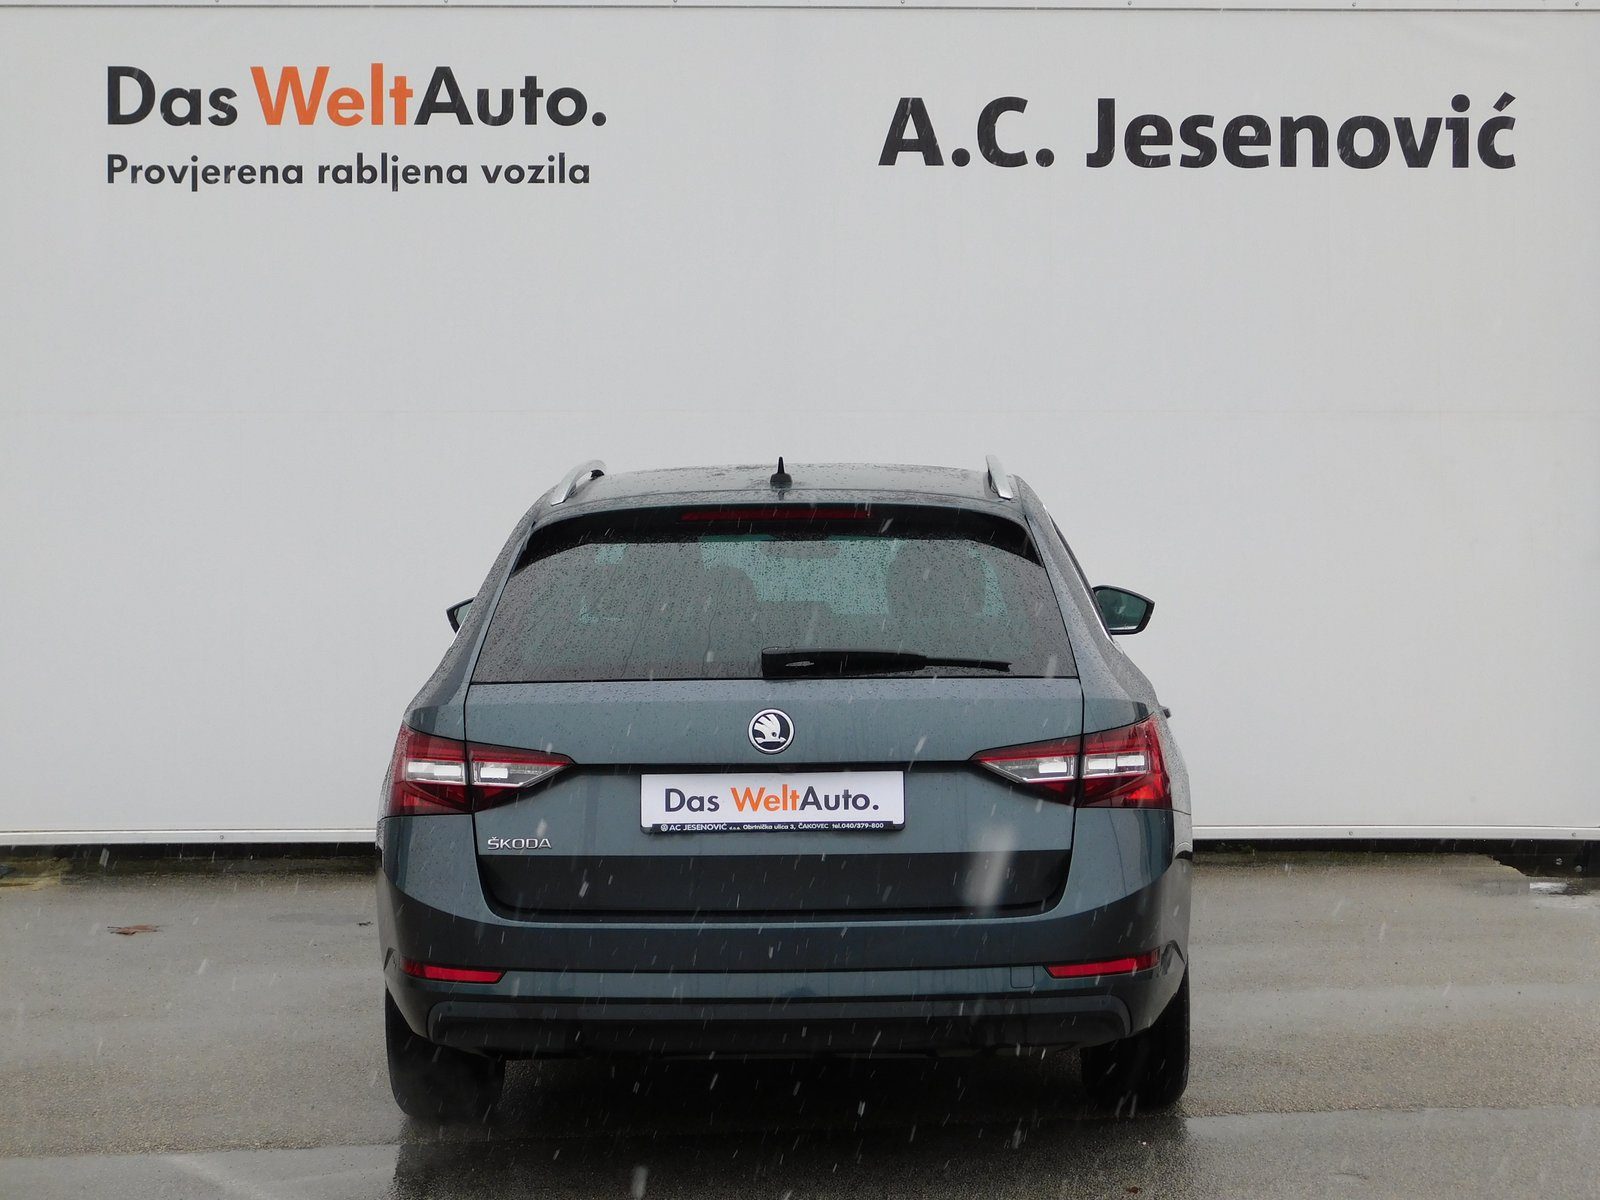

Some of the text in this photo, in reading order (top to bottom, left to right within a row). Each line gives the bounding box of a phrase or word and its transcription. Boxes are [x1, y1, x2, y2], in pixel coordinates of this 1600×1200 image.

[107, 62, 607, 127] Das WeltAuto.
[878, 91, 1516, 170] A.C. Jesenović
[107, 152, 590, 193] Provjerena rabljena vozila
[665, 784, 880, 812] Das WeltAuto.
[487, 836, 552, 850] ŠKODA
[683, 822, 727, 831] JESENOVIĆ
[798, 822, 829, 830] ČAKOVEC
